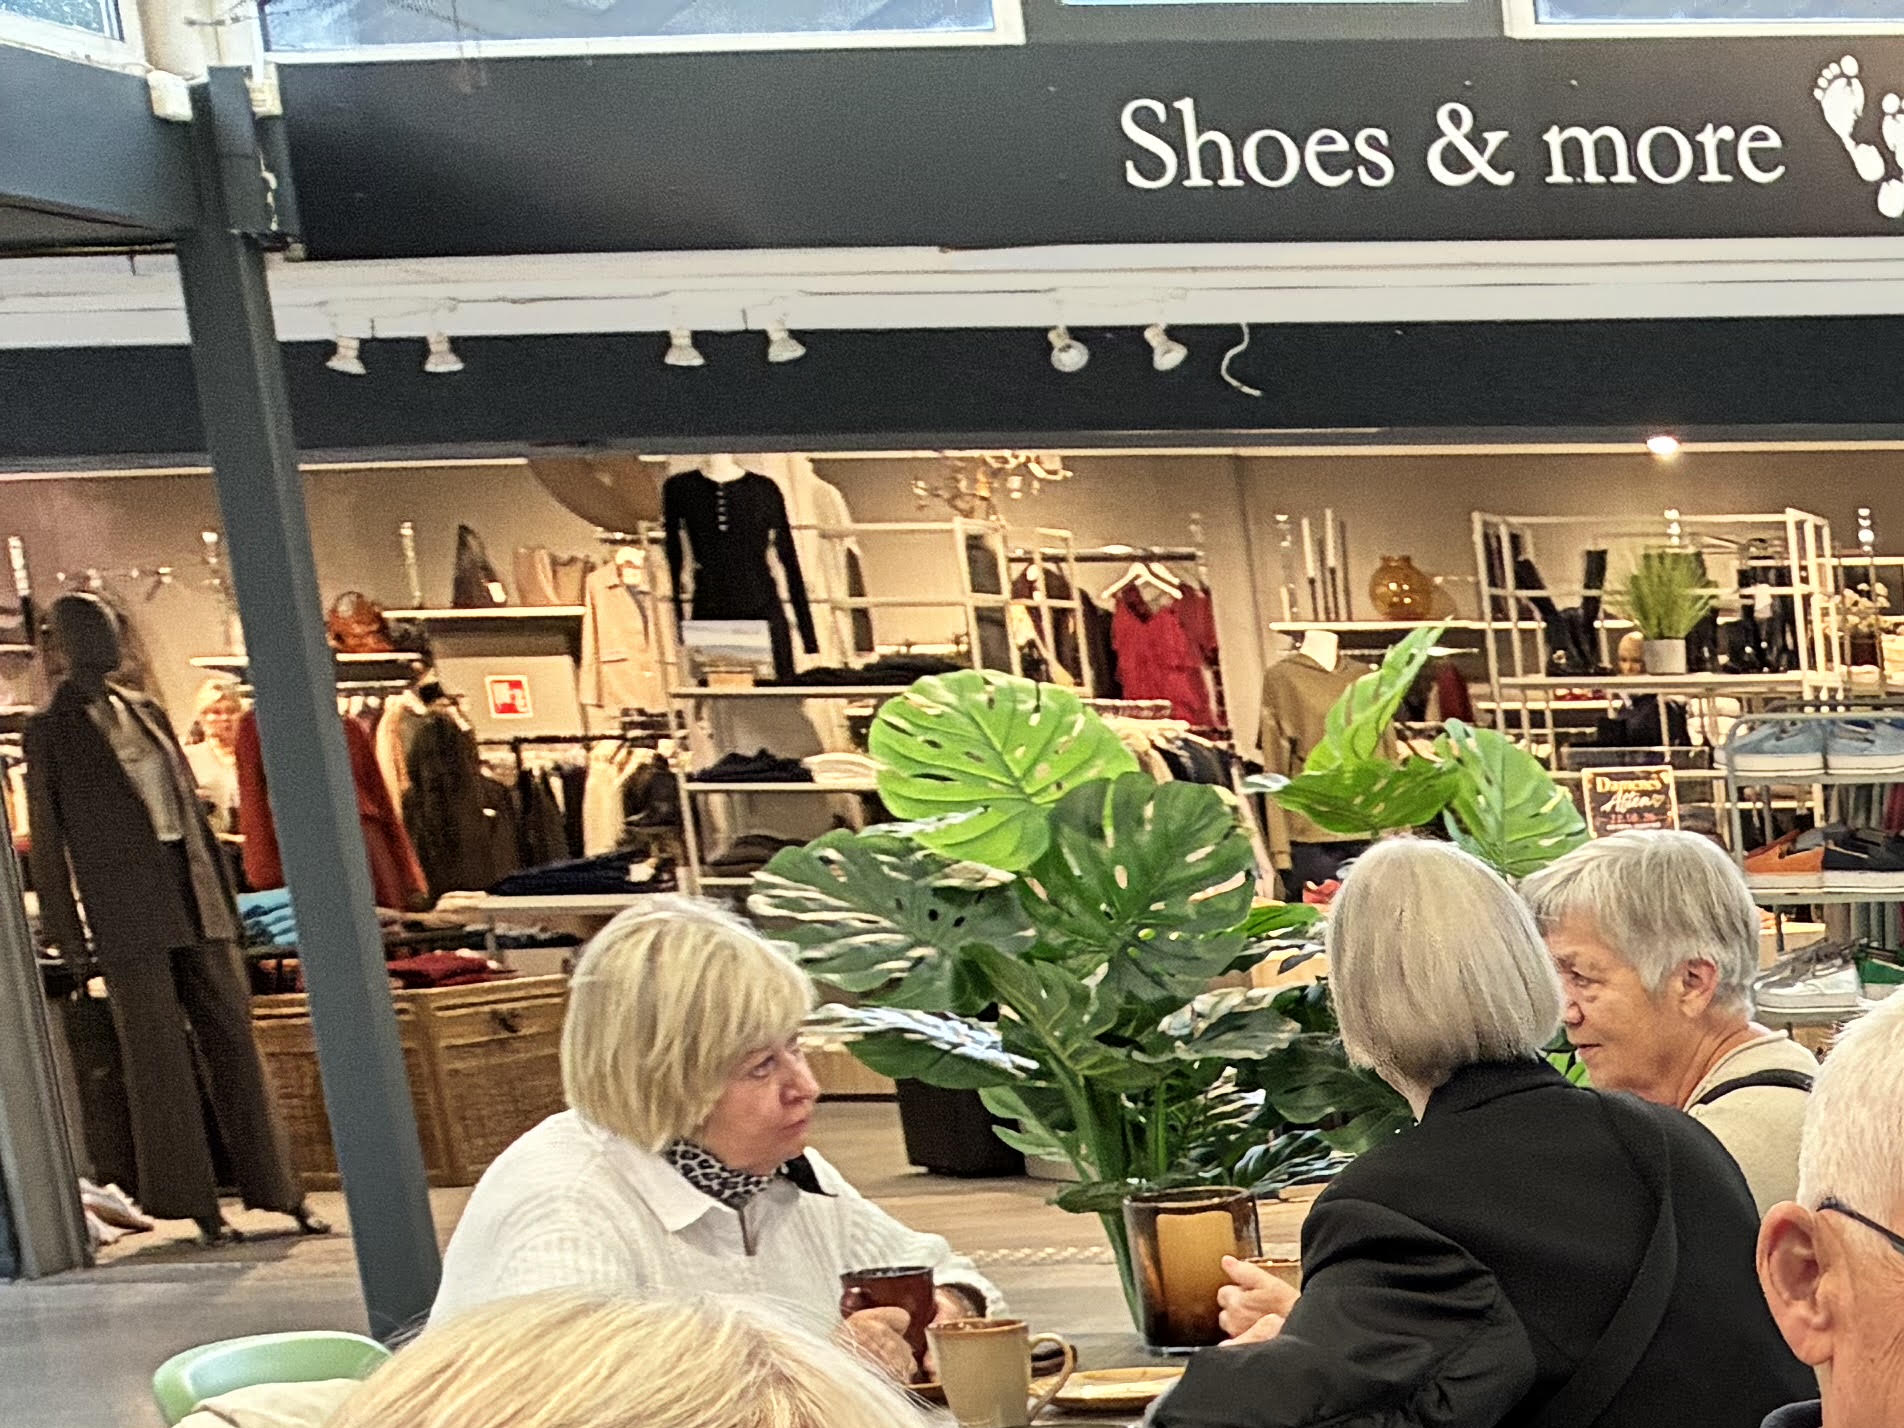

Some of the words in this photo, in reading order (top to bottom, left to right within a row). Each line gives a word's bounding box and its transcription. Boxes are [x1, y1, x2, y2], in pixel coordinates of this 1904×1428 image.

[1121, 97, 1395, 189] Shoes
[1426, 101, 1515, 187] &
[1542, 122, 1786, 184] more
